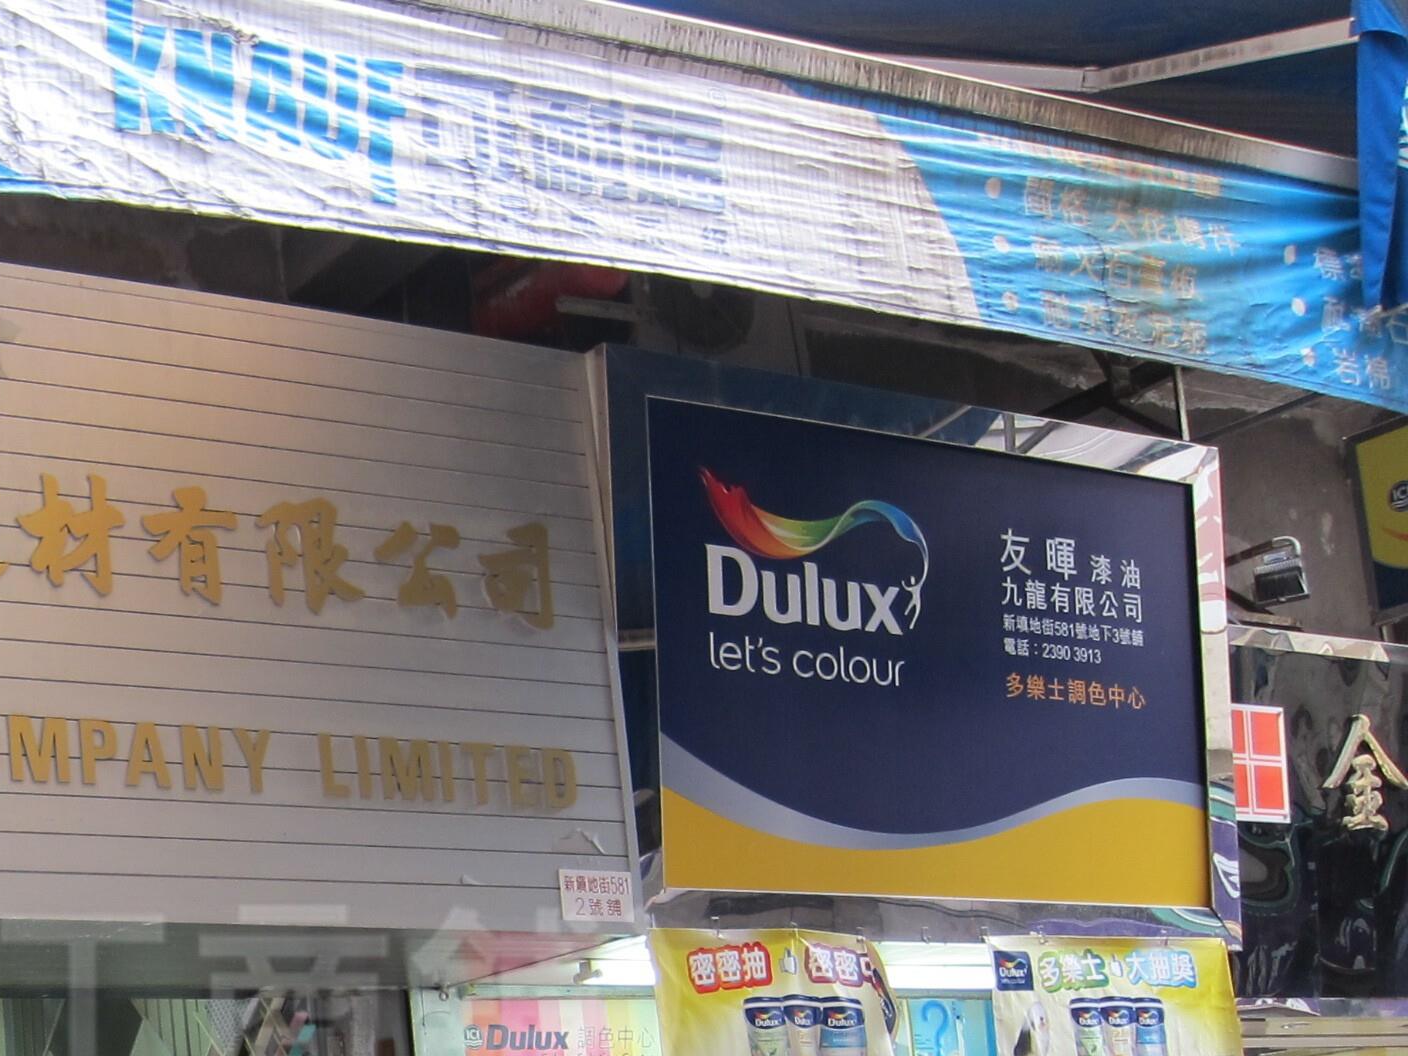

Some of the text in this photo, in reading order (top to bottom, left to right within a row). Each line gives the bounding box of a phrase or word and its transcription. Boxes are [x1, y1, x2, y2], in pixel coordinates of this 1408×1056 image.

[106, 0, 407, 206] KNAUF
[1000, 528, 1142, 590] 友暉漆油
[704, 543, 904, 636] Dulux
[1001, 576, 1143, 624] 九龍有限公司
[709, 632, 906, 687] let's colour
[1006, 672, 1146, 710] 多樂士調色中心
[317, 733, 578, 811] LIMITED
[1323, 714, 1408, 831] 金
[690, 943, 767, 986] 密密抽
[1039, 950, 1106, 986] 多樂士
[1125, 948, 1196, 984] 大抽獎
[487, 1024, 570, 1050] Dulux
[577, 1025, 656, 1050] 調色中心
[755, 1016, 780, 1028] Dulux
[827, 1016, 855, 1028] Dulux
